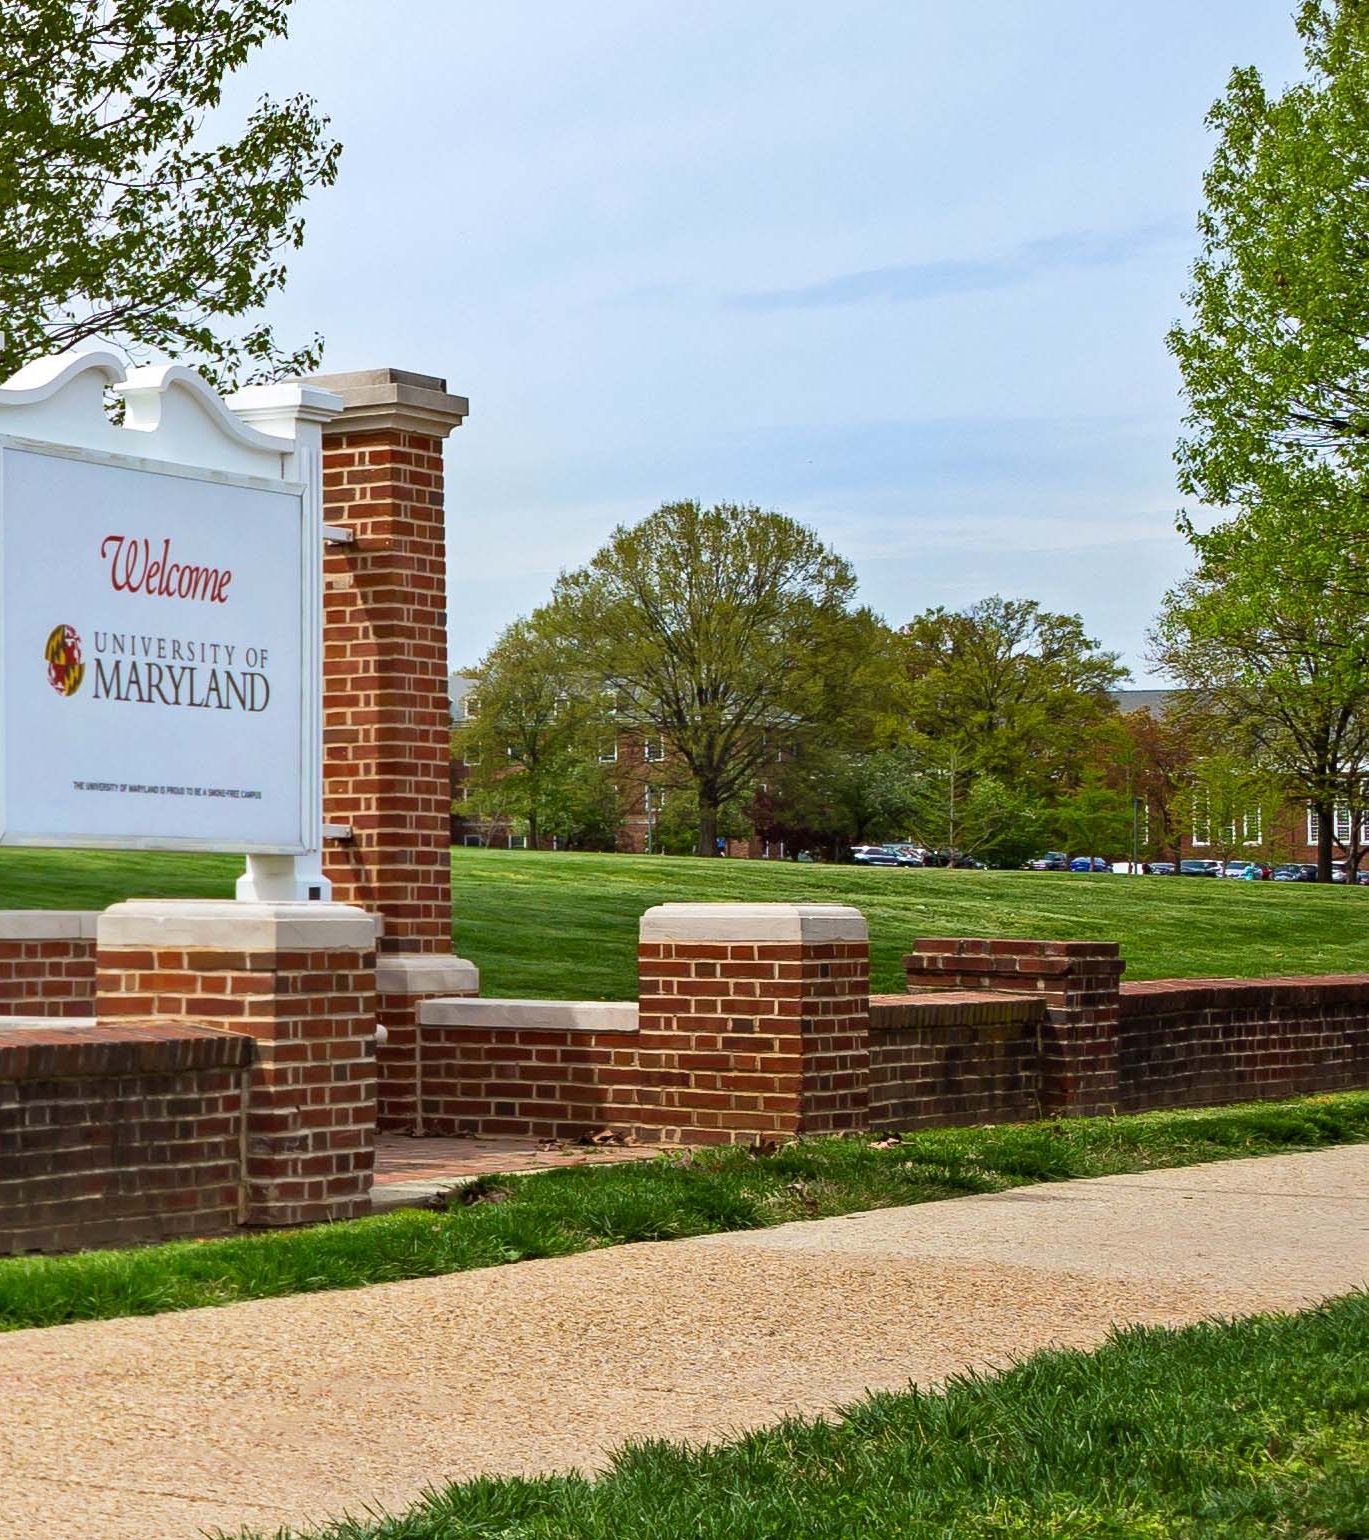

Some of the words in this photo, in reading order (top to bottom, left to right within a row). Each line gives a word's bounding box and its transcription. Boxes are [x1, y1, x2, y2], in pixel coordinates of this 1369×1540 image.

[100, 536, 232, 604] Welcome
[93, 631, 236, 666] UNIVERSITY
[245, 646, 269, 669] OF
[92, 657, 271, 712] MARYLAND
[73, 781, 85, 791] THE
[86, 782, 118, 792] UNIVERSITY
[120, 783, 128, 792] OF
[128, 784, 159, 794] MARYLAND
[186, 787, 193, 796] TO
[241, 790, 262, 800] CAMPUS
